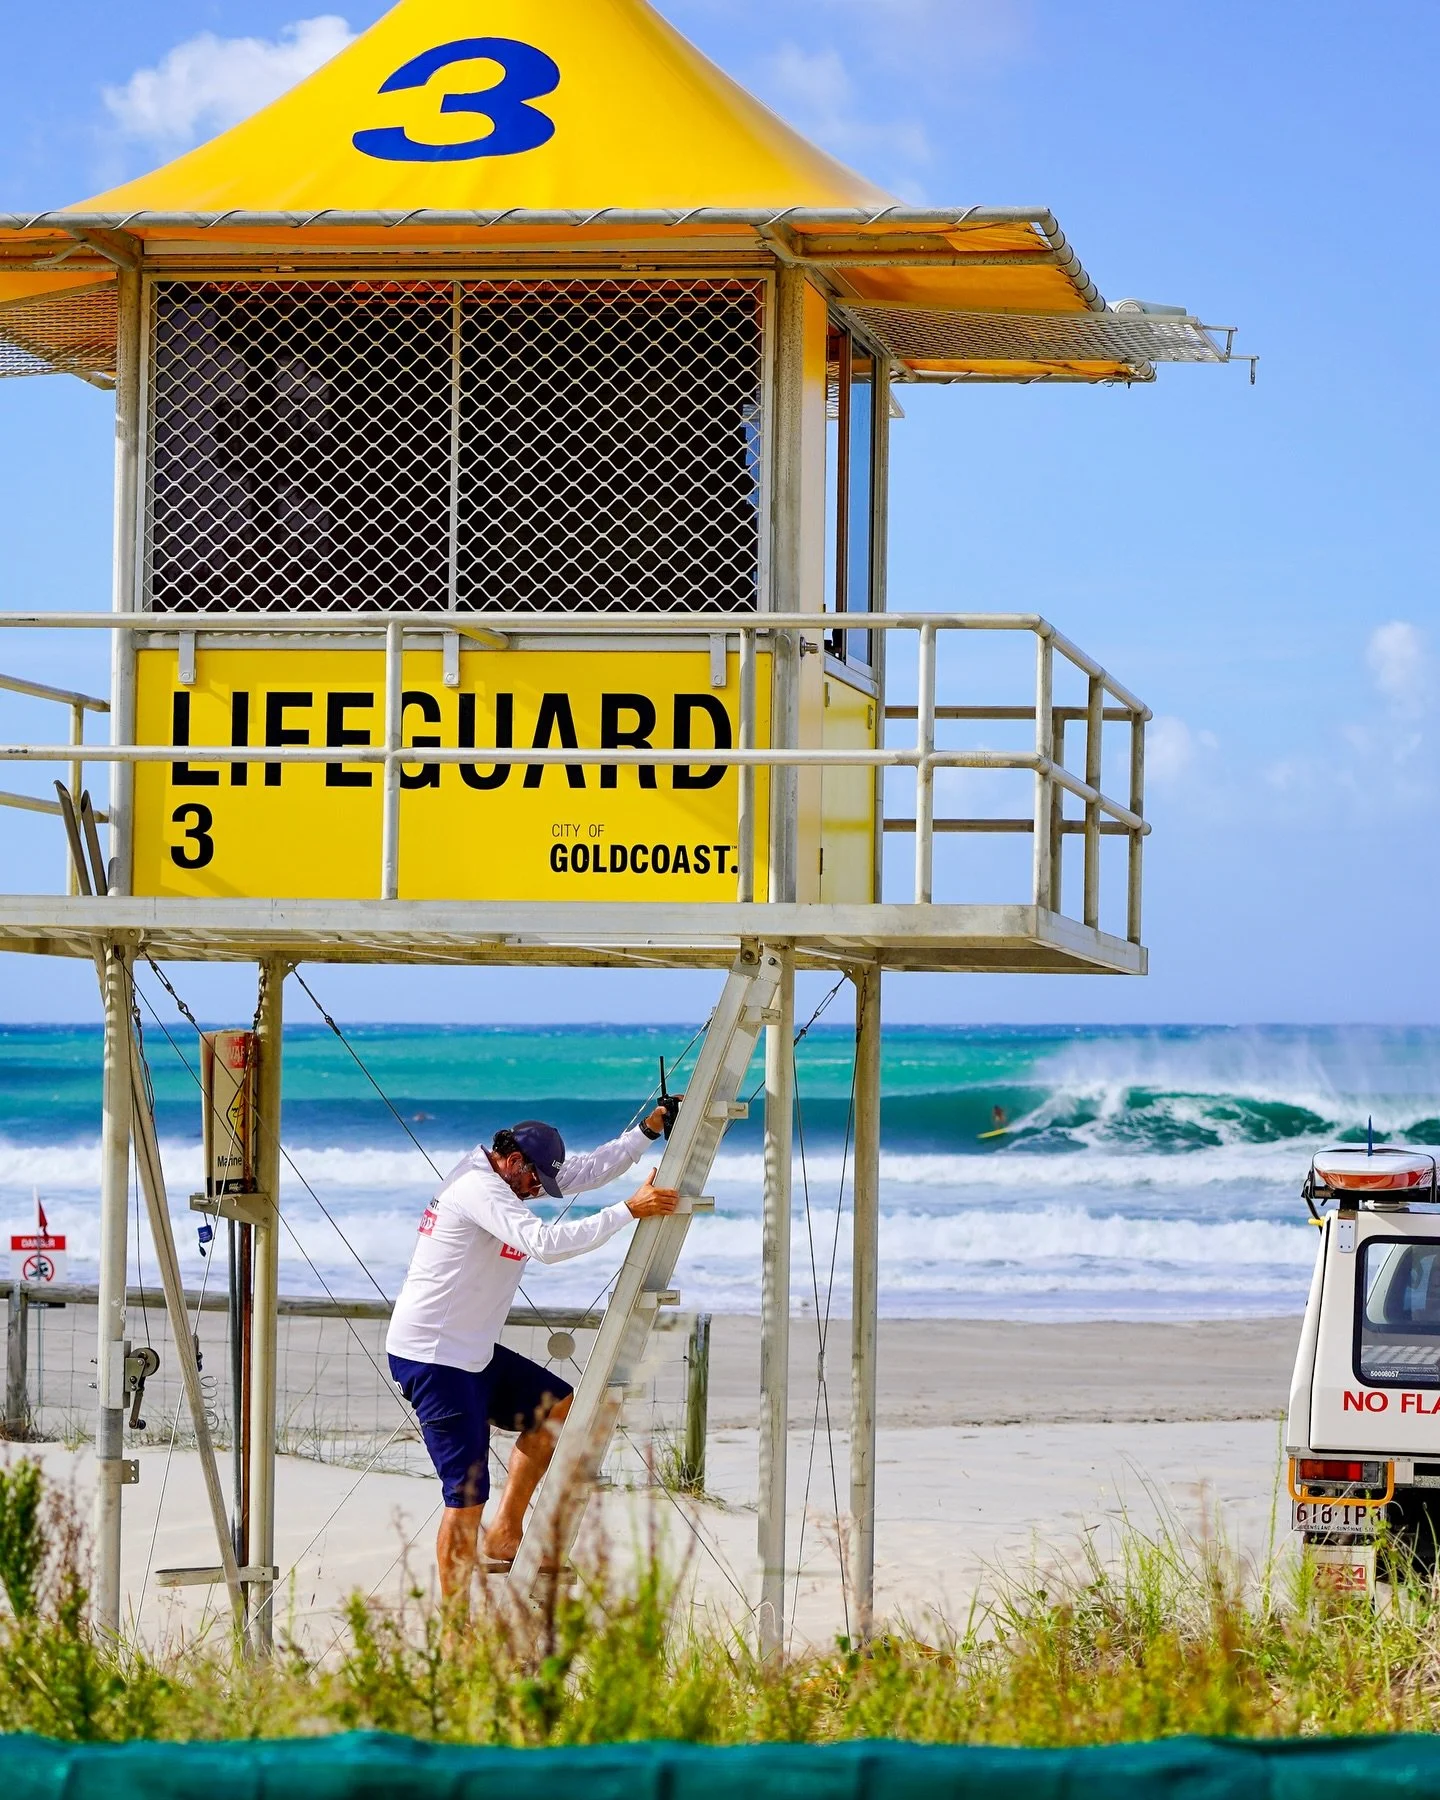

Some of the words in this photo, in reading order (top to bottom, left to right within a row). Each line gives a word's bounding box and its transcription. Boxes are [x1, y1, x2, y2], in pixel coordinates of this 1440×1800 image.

[352, 37, 561, 162] 3
[172, 690, 733, 790] LIFEGUARD
[170, 803, 215, 870] 3
[551, 823, 581, 838] CITY
[587, 823, 606, 838] OF
[1343, 1390, 1388, 1413] NO
